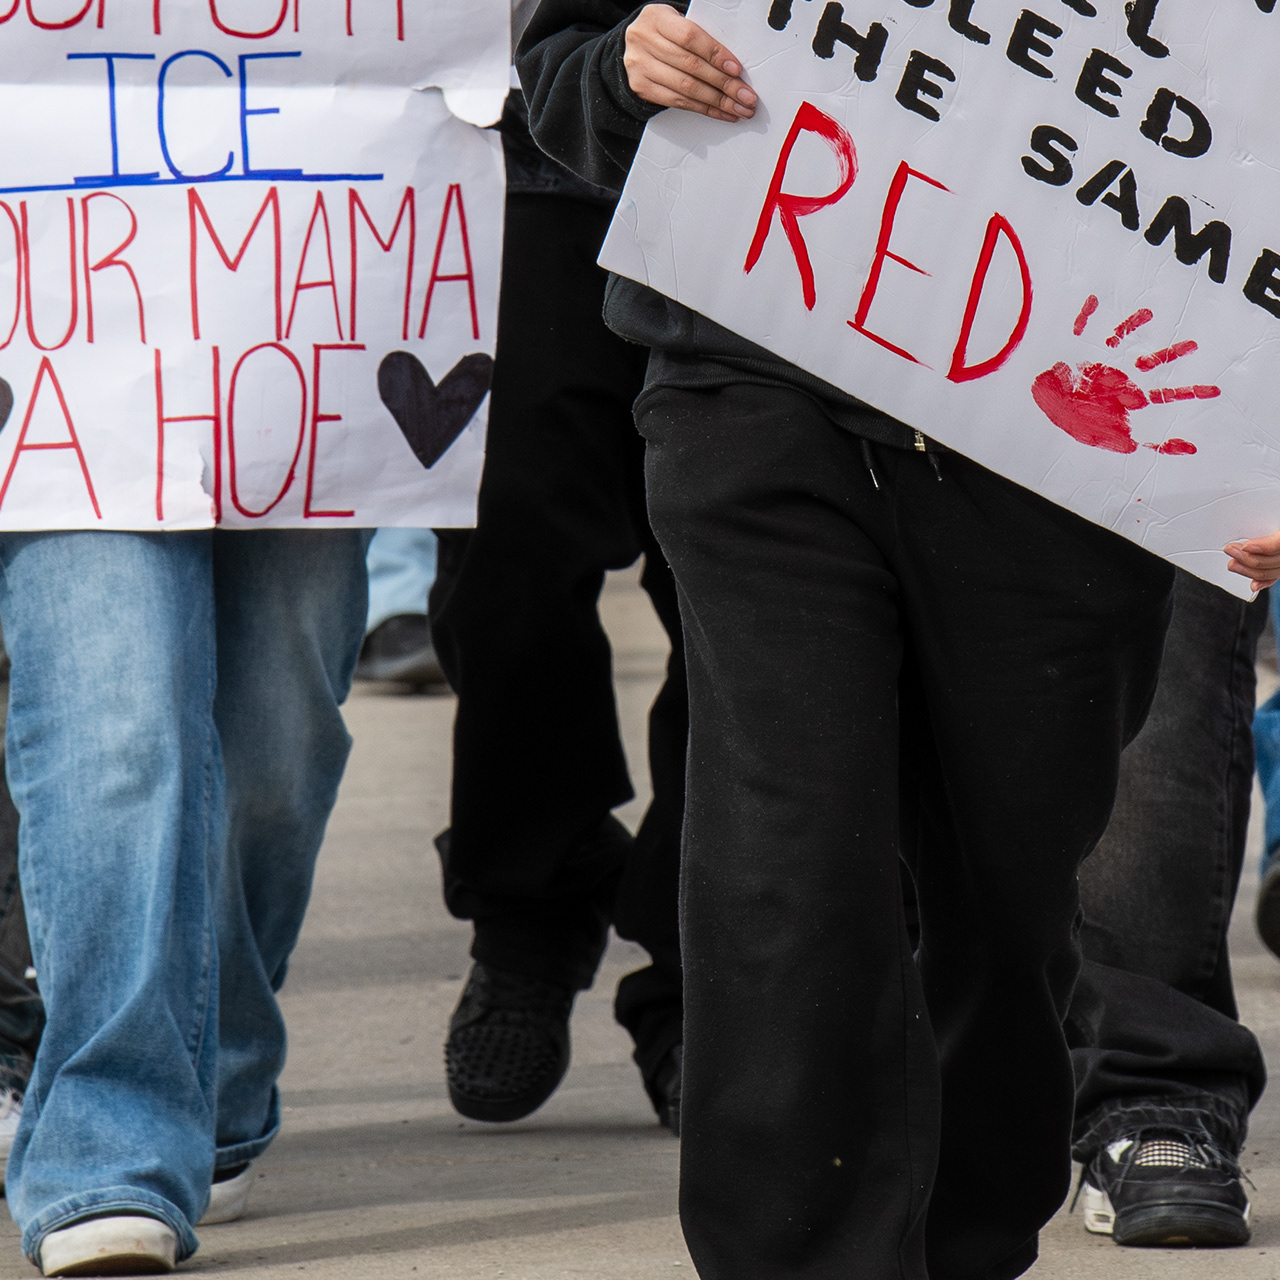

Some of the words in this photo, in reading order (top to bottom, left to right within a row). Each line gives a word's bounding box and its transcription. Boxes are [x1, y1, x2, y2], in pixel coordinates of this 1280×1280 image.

[66, 49, 304, 182] ICE
[188, 183, 481, 343] MAMA
[742, 100, 1034, 384] RED
[154, 342, 368, 521] HOE
